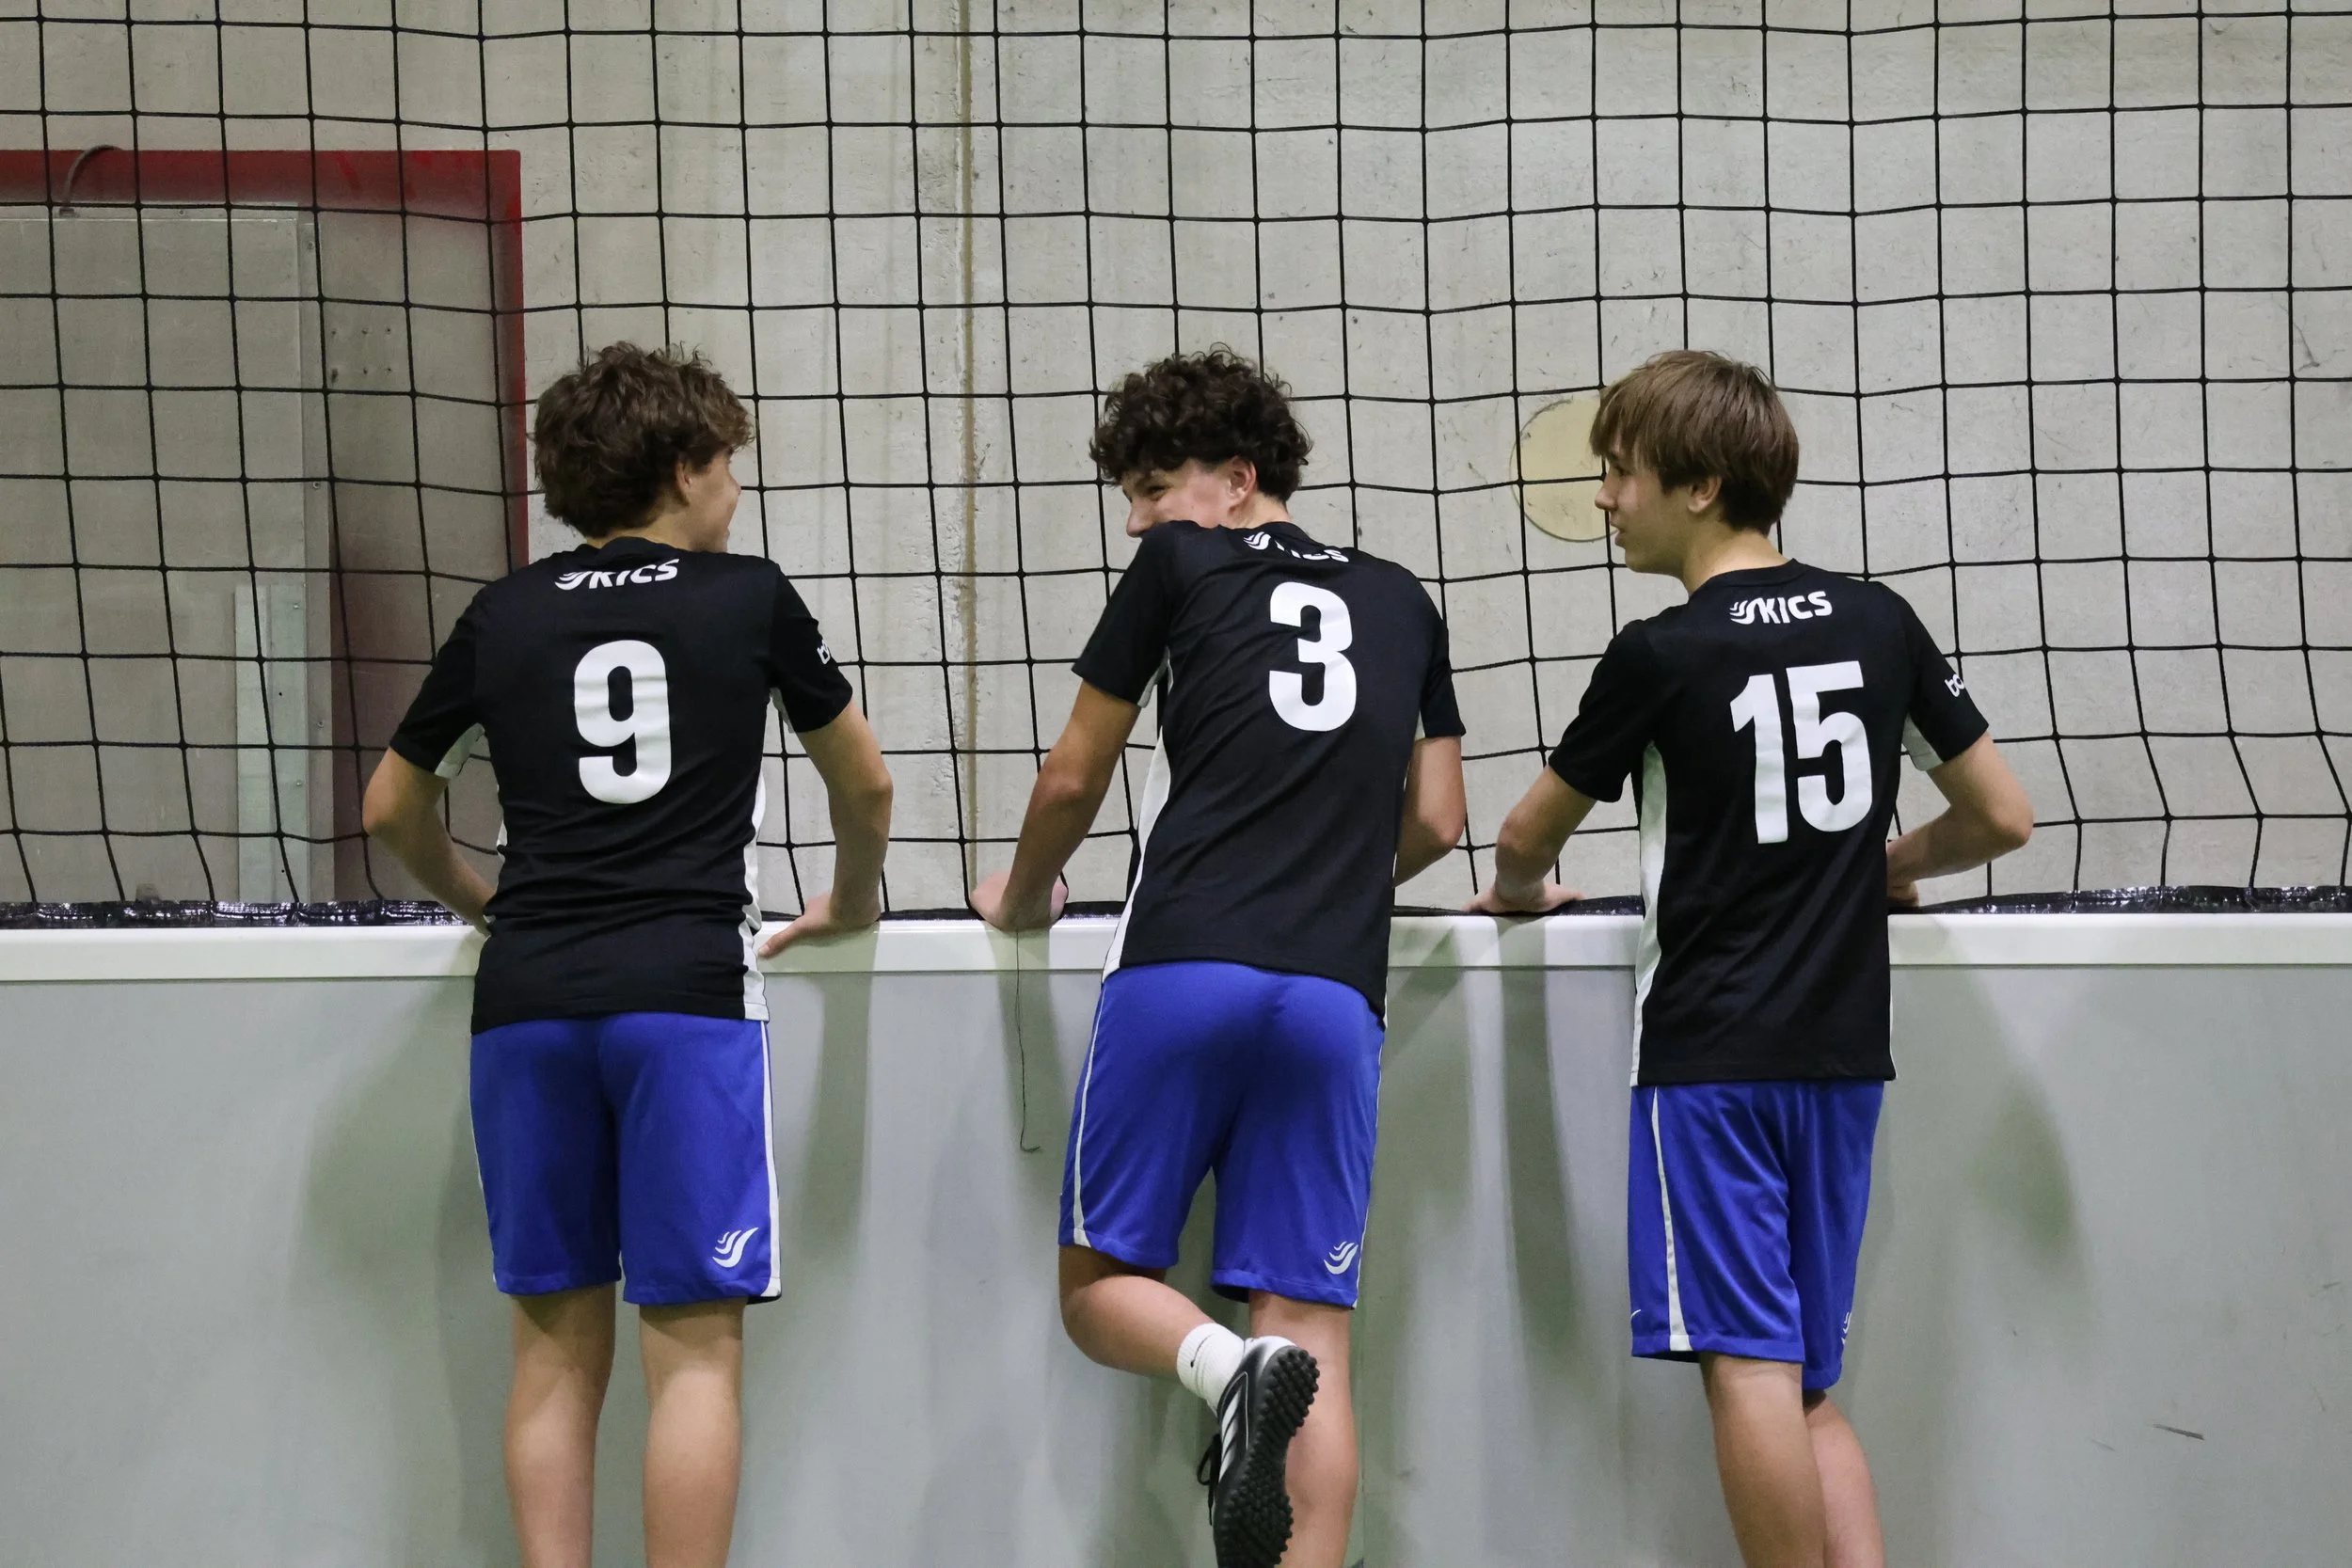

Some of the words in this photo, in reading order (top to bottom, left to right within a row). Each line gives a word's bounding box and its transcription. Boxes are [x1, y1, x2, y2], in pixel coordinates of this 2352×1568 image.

[589, 559, 679, 589] KICS
[1756, 591, 1833, 624] KICS
[574, 641, 671, 803] 9
[1269, 582, 1357, 731] 3
[1730, 661, 1872, 844] 15
